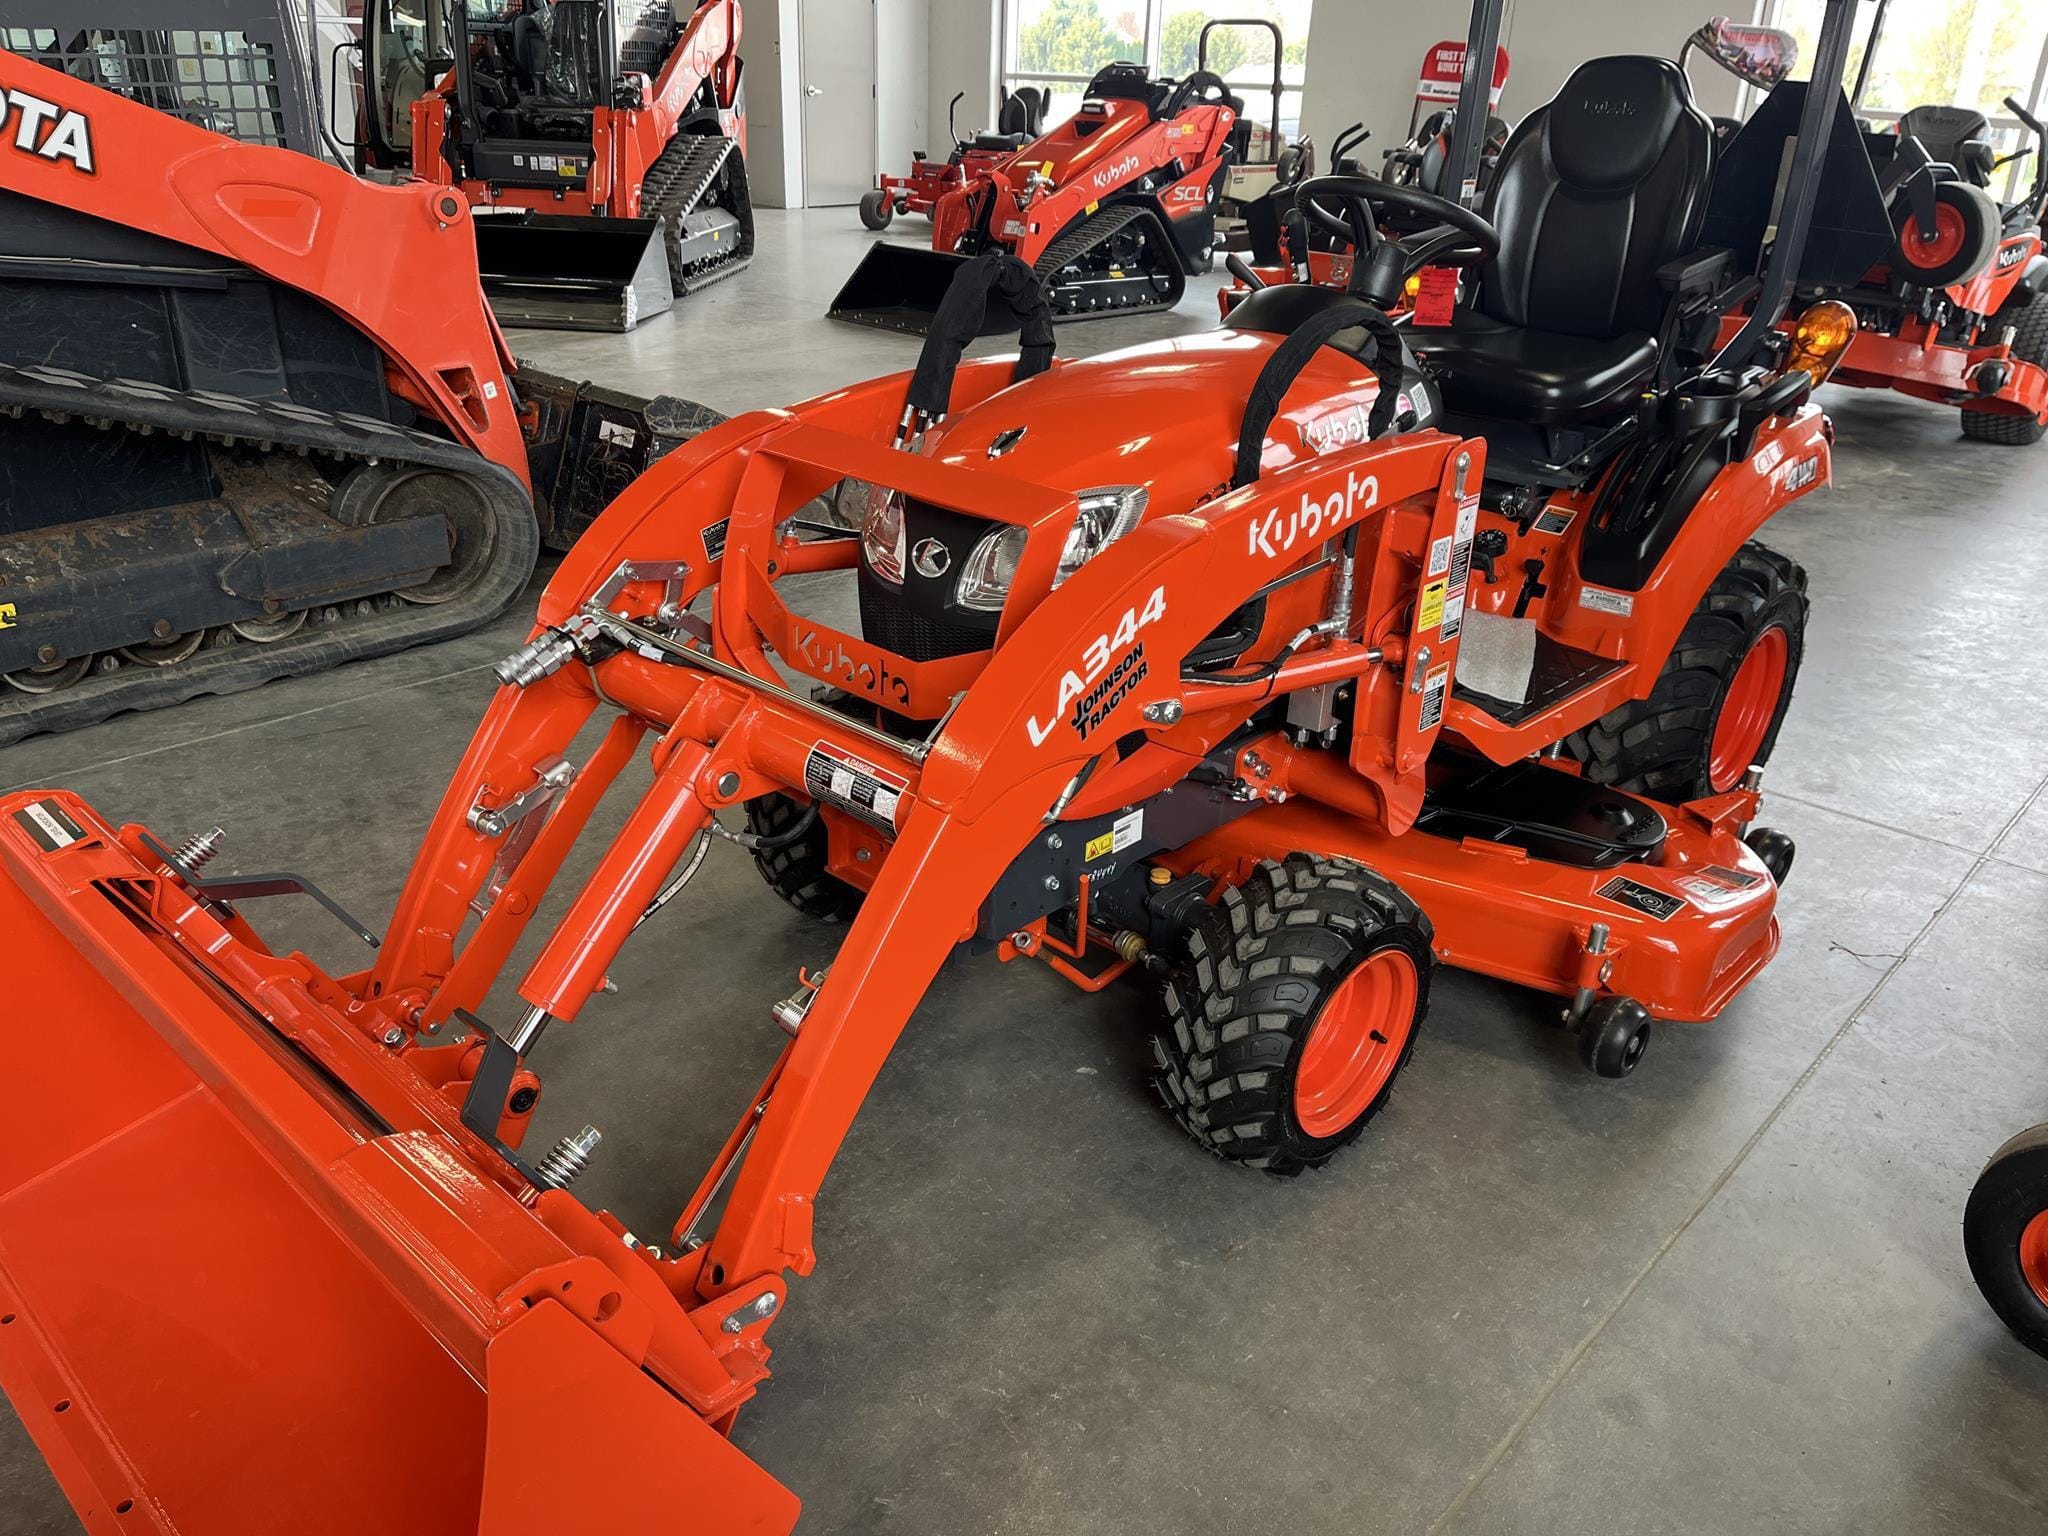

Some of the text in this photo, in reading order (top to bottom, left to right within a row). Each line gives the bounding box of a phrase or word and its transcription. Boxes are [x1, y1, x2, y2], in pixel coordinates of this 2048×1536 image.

[0, 87, 93, 173] TA
[1092, 155, 1139, 188] Kubota
[1172, 185, 1204, 201] SCL
[1296, 404, 1370, 453] Kubot
[1248, 471, 1379, 559] Kubota
[793, 624, 911, 706] Kubota
[1026, 584, 1167, 748] LA344
[1071, 641, 1145, 728] JOHNSON
[1076, 660, 1148, 741] TRACTOR
[849, 757, 877, 774] DANGER
